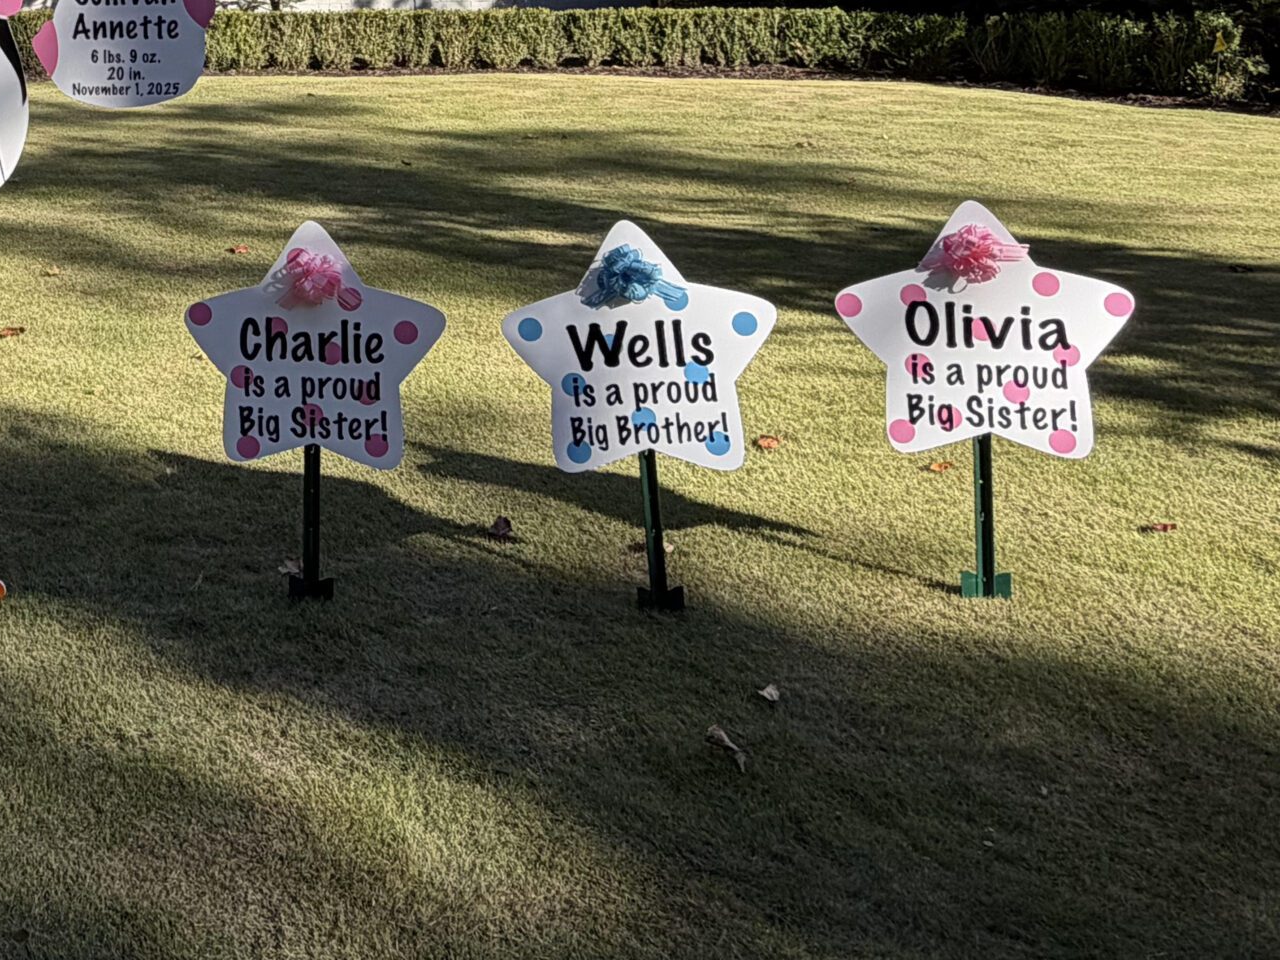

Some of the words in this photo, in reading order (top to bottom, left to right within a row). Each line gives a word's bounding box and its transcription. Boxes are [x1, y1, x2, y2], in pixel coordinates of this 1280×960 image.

[72, 13, 179, 40] Annette
[91, 50, 98, 63] 6
[104, 50, 125, 63] lbs.
[129, 50, 137, 63] 9
[142, 53, 161, 63] oz.
[107, 67, 124, 80] 20
[129, 68, 144, 80] in.
[72, 84, 130, 95] November
[136, 84, 143, 96] 1,
[147, 83, 180, 95] 2025
[240, 316, 384, 364] Charlie
[905, 300, 1071, 351] Olivia
[566, 319, 715, 372] Wells
[243, 368, 265, 398] is
[275, 378, 290, 398] a
[301, 372, 381, 405] proud
[572, 377, 595, 407] is
[606, 384, 623, 405] a
[633, 373, 718, 412] proud
[911, 354, 935, 385] is
[946, 364, 964, 385] a
[977, 360, 1068, 393] proud
[238, 406, 280, 443] Big
[290, 407, 387, 442] Sister!
[570, 417, 608, 451] Big
[616, 412, 729, 445] Brother!
[907, 394, 954, 432] Big
[965, 395, 1078, 432] Sister!
